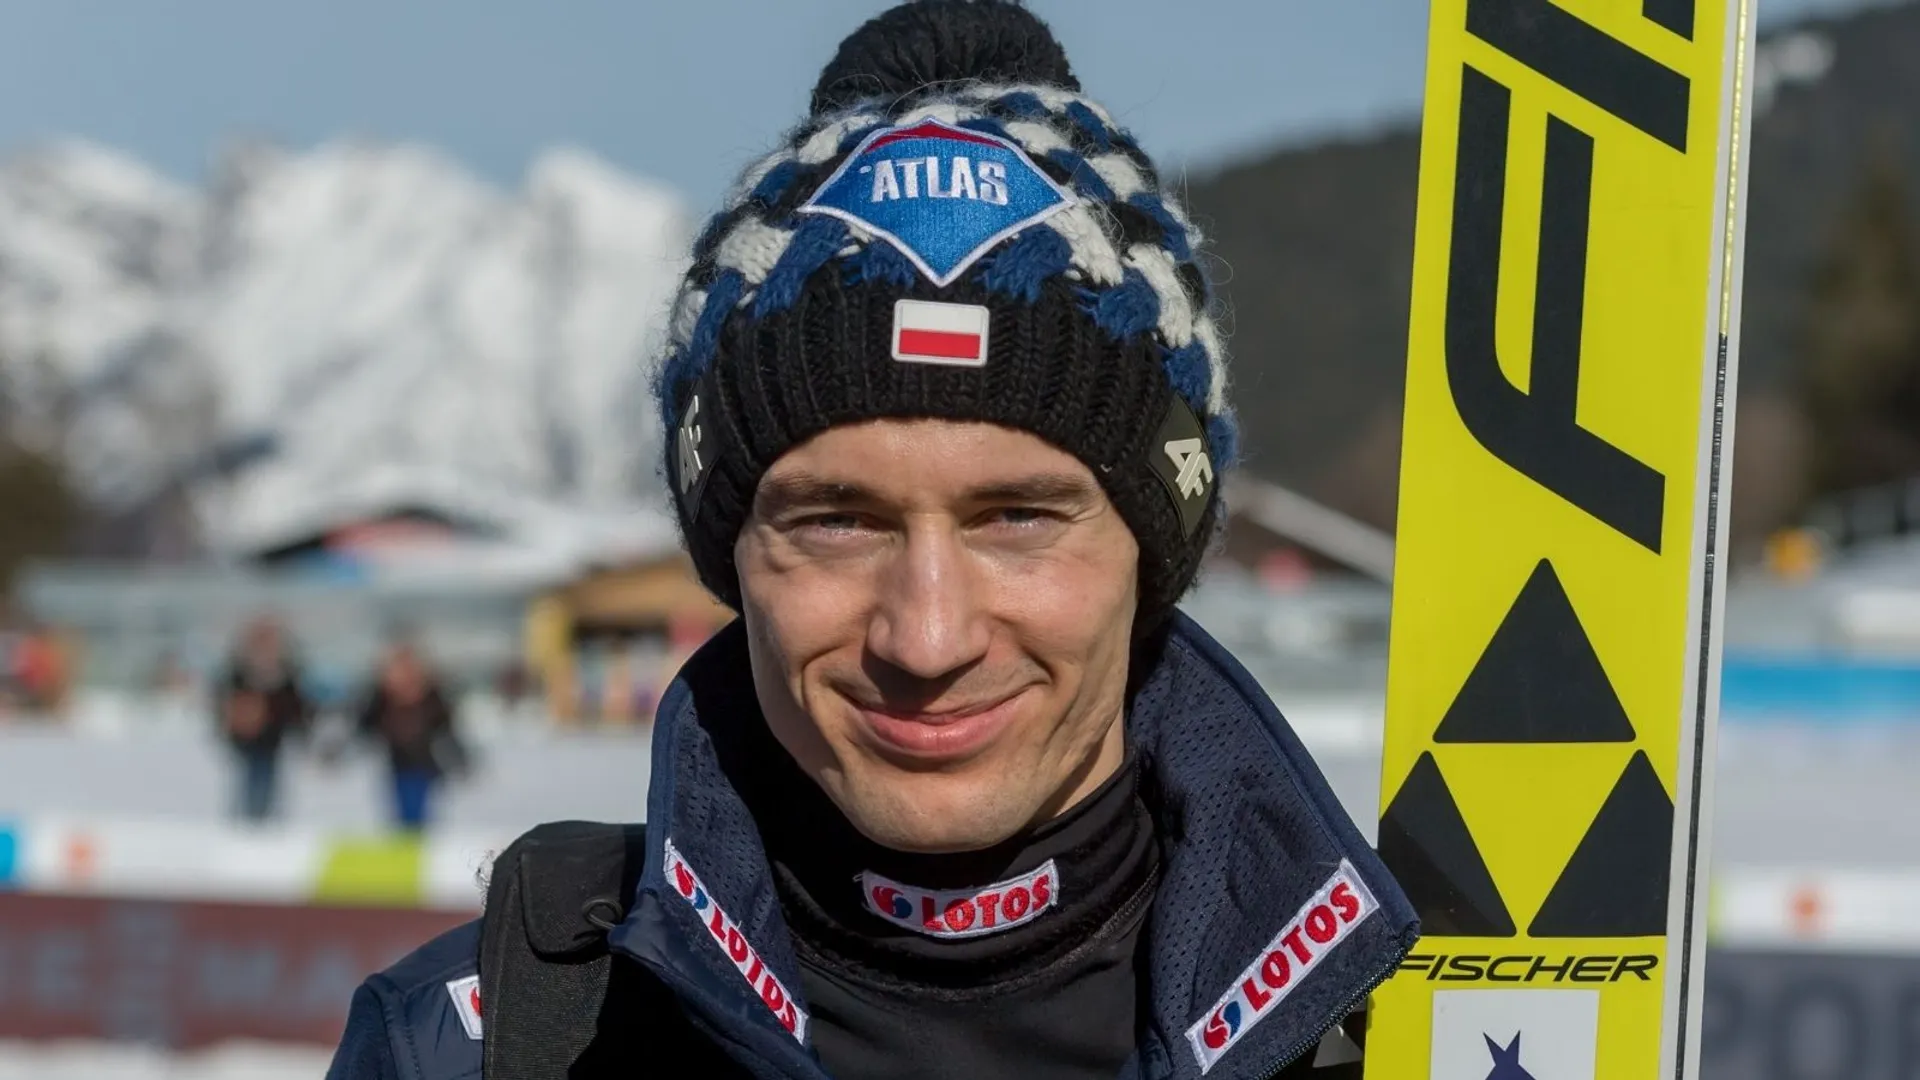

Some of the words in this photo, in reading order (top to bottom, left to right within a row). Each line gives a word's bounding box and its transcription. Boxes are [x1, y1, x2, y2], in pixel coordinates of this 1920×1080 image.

[871, 155, 1009, 206] ATLAS
[922, 874, 1050, 932] LOTOS
[1242, 882, 1360, 1012] LOTOS
